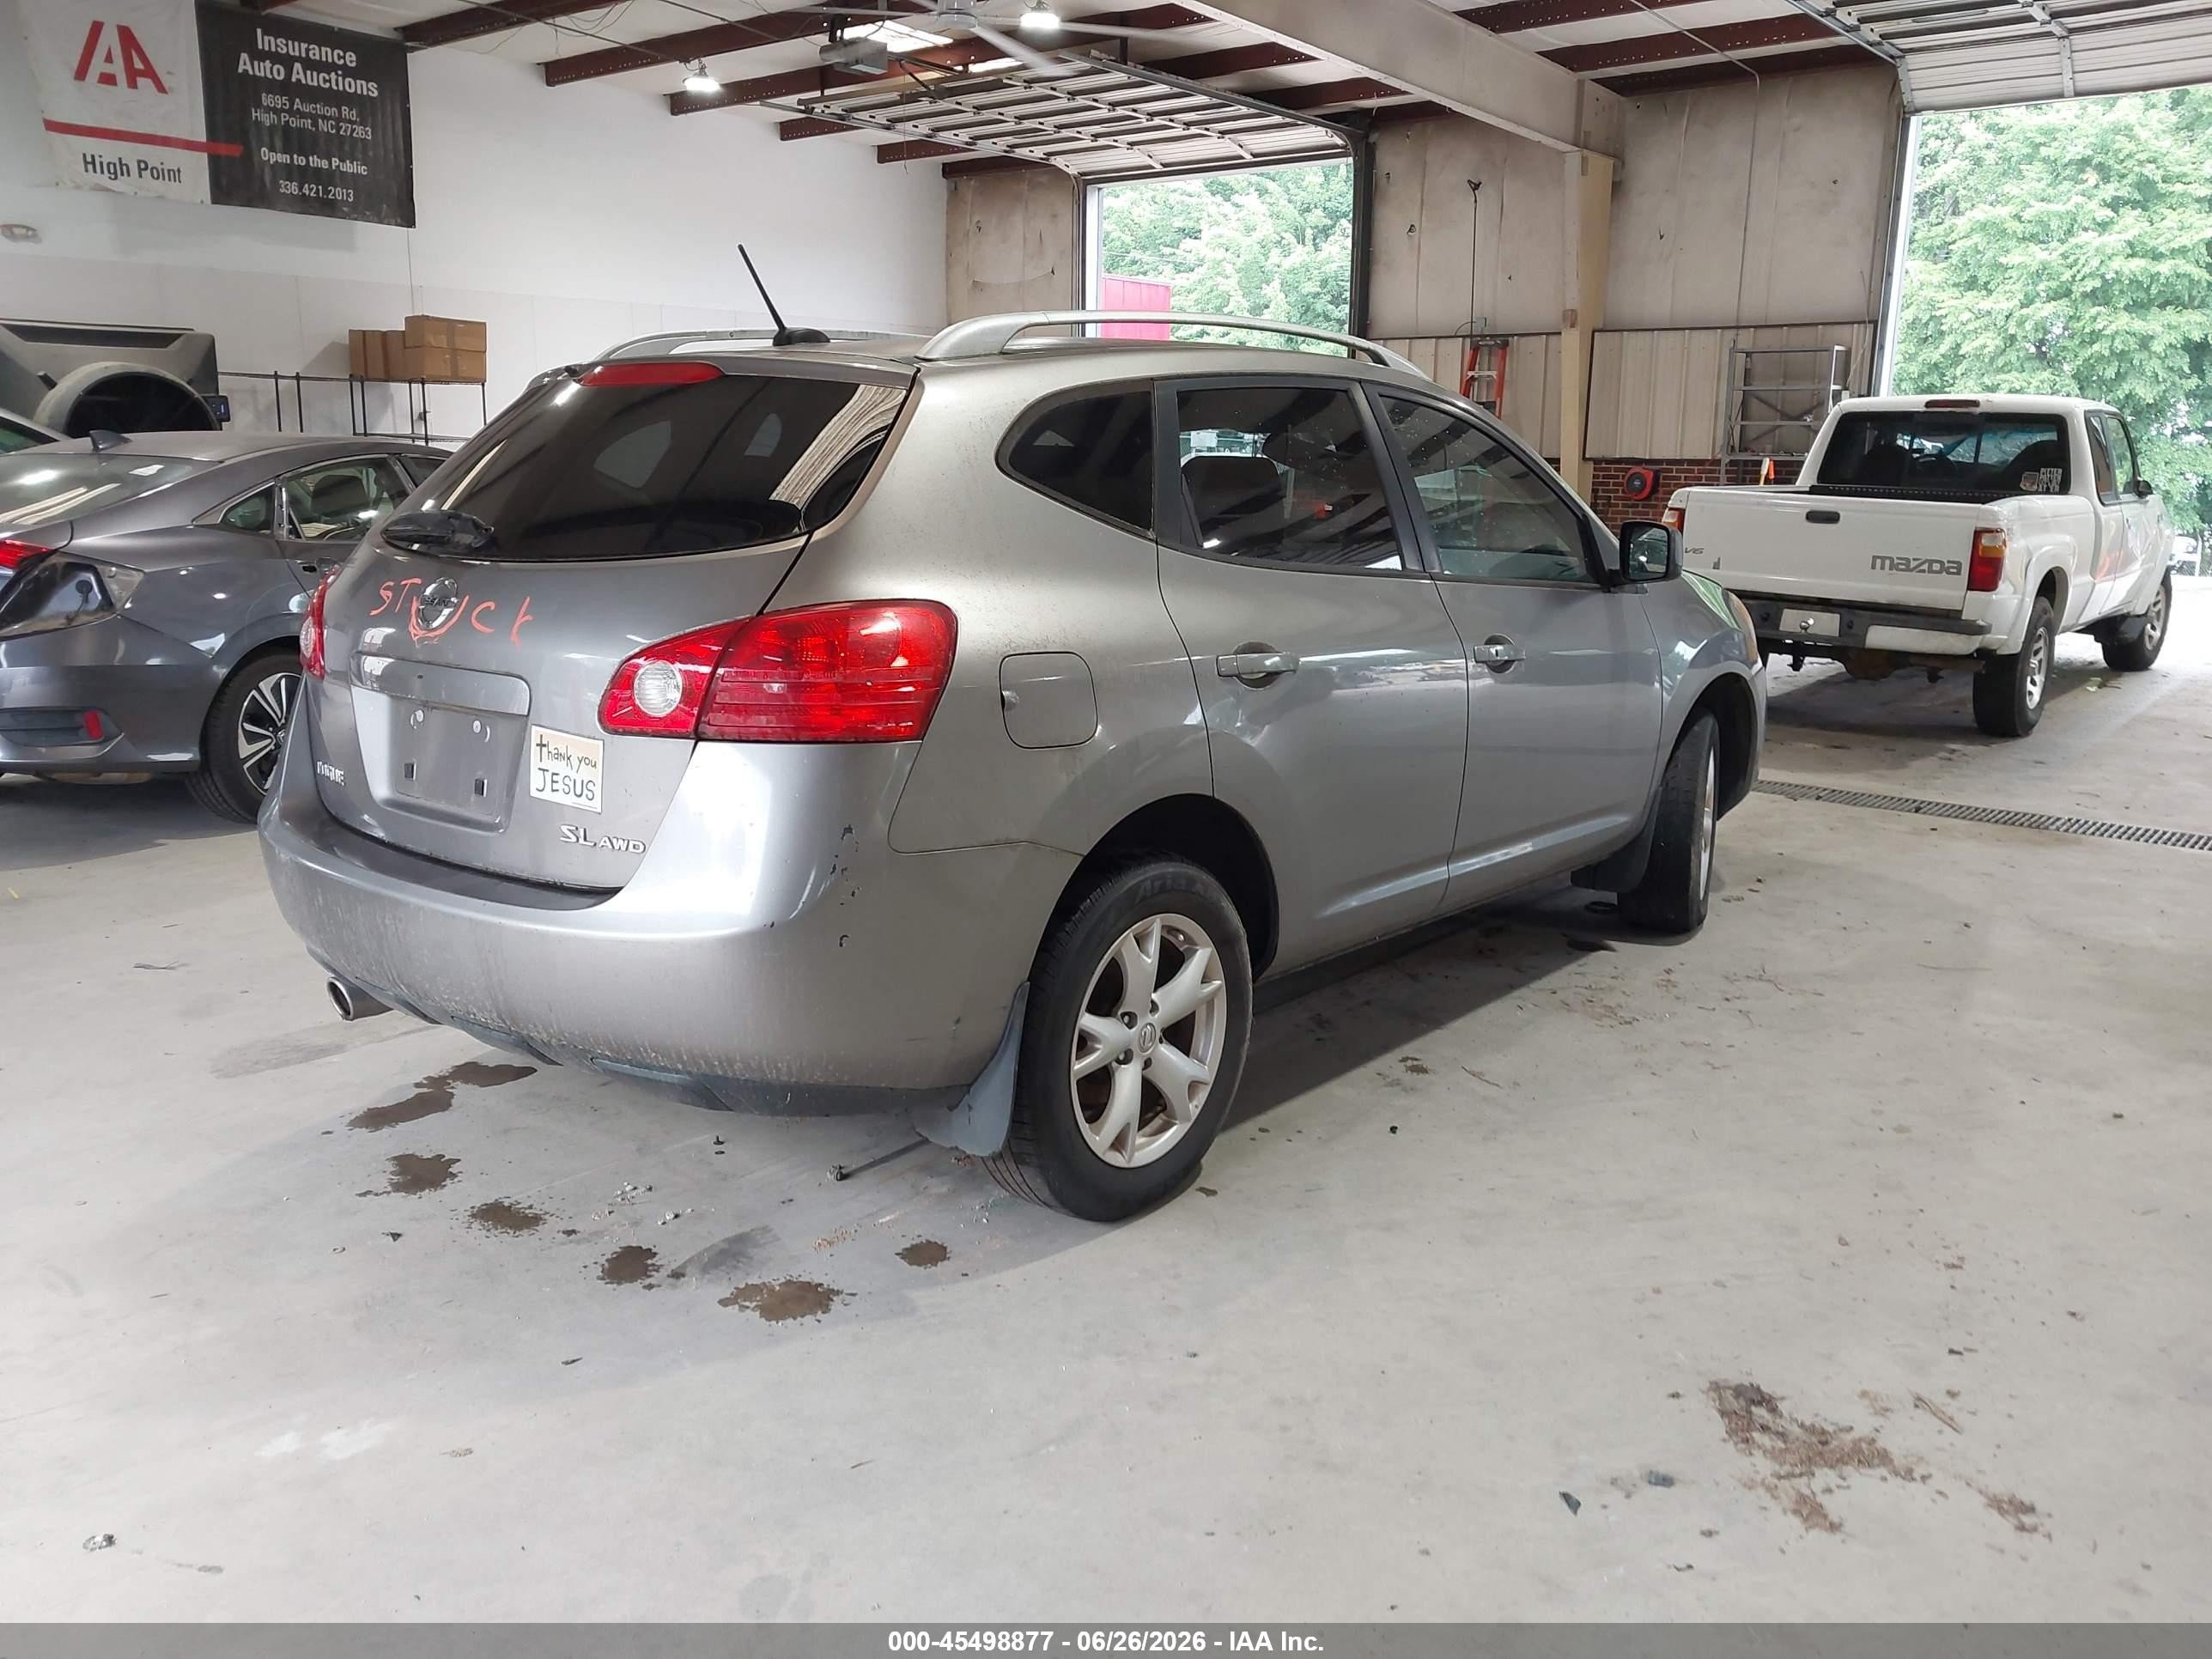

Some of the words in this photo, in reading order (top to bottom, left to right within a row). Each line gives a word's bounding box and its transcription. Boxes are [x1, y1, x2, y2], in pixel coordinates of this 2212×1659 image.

[256, 28, 357, 67] Insurance
[237, 52, 285, 80] Auto
[291, 62, 379, 97] Auctions
[261, 93, 289, 110] 6695
[294, 98, 338, 117] Auction
[252, 107, 277, 126] High
[281, 112, 315, 131] Point,
[319, 120, 336, 133] NC
[339, 123, 372, 140] 27263
[82, 153, 131, 181] High
[137, 159, 182, 184] Point
[260, 147, 290, 164] Open
[294, 155, 306, 166] to
[309, 155, 329, 168] the
[331, 157, 368, 175] Public
[279, 179, 354, 202] 336.421.2013
[1684, 546, 1705, 555] V6
[577, 756, 597, 774] you
[535, 767, 596, 801] JESUS
[559, 823, 598, 847] SL
[598, 835, 647, 854] AWD
